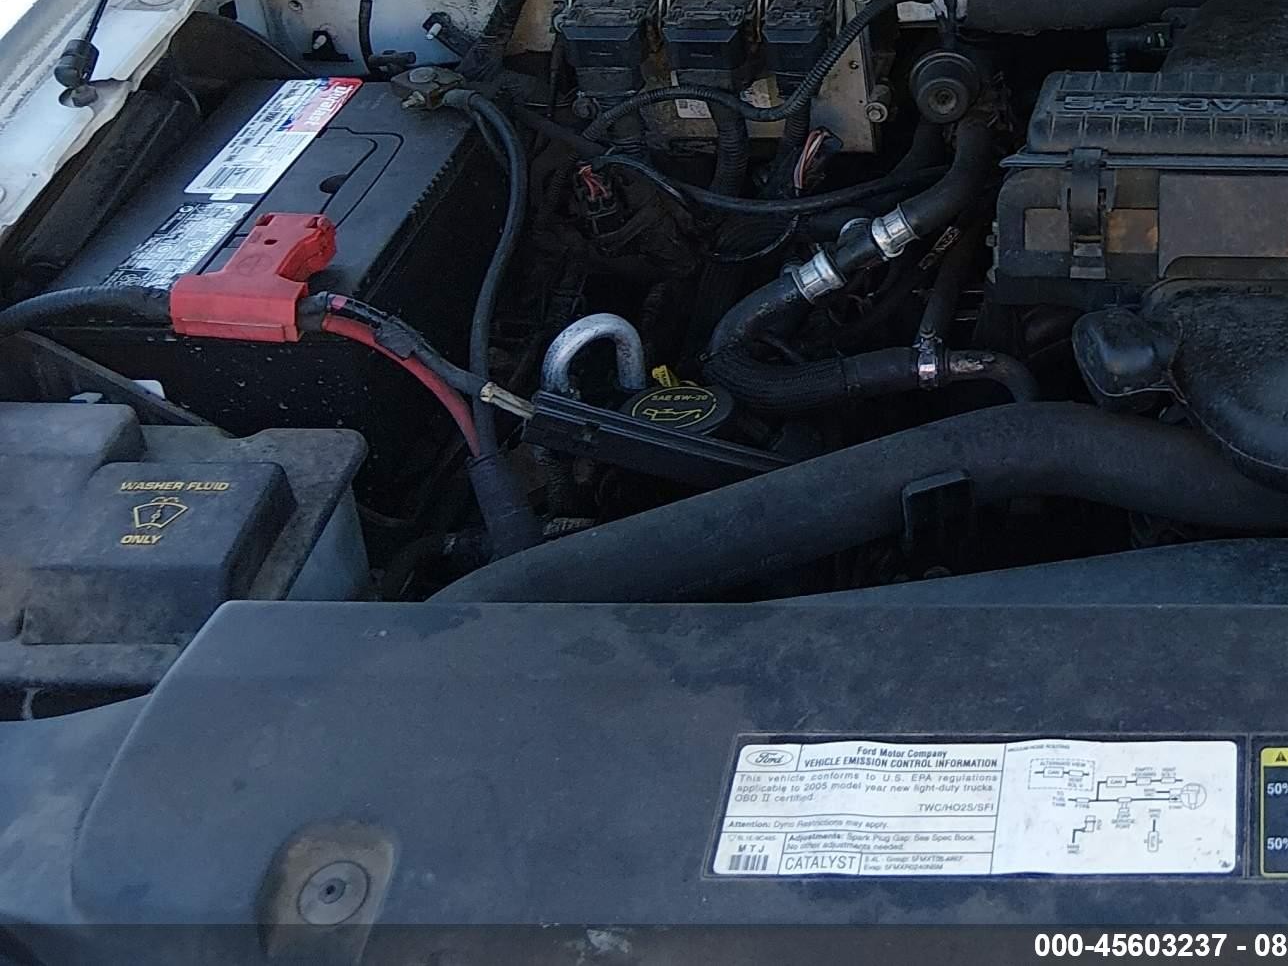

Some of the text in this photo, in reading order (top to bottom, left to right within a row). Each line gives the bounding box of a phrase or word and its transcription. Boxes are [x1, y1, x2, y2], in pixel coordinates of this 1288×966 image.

[120, 481, 230, 491] WASHER FLUID
[120, 534, 163, 545] ONLY
[755, 753, 785, 763] Ford
[857, 746, 948, 759] Ford Motor Company
[804, 756, 998, 768] VEHICLE EMISSION CONTROL INFORMATION
[739, 774, 761, 782] This
[768, 774, 806, 782] vehicle
[810, 772, 860, 781] conforms
[866, 772, 877, 781] to
[911, 774, 932, 782] EPA
[938, 774, 998, 784] regulations
[736, 784, 787, 793] applicable
[790, 784, 800, 792] to
[803, 782, 828, 791] 2005
[830, 782, 862, 790] model
[864, 785, 888, 793] year
[738, 844, 765, 852] M T J
[785, 856, 857, 870] CATALYST
